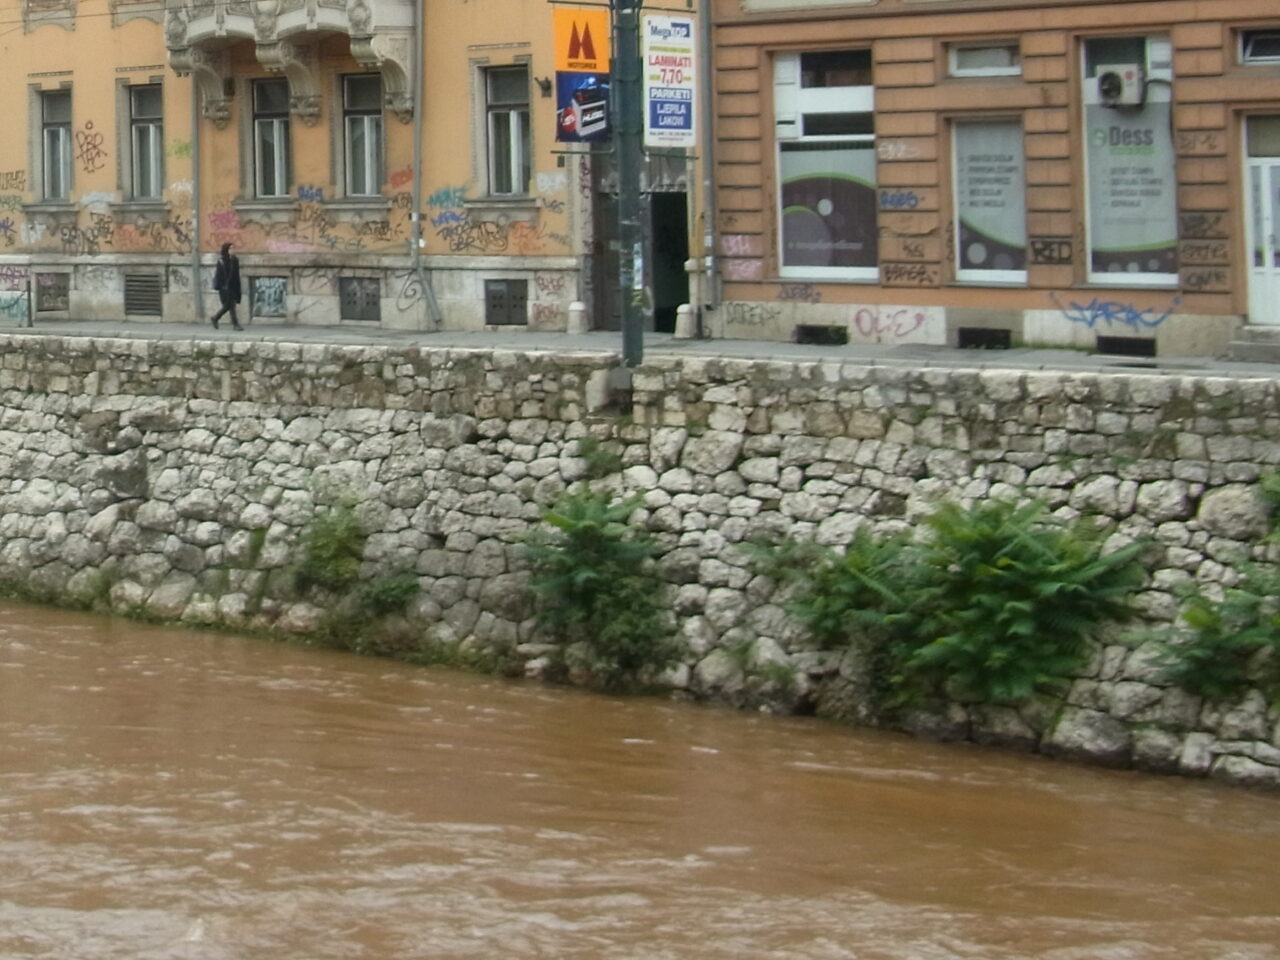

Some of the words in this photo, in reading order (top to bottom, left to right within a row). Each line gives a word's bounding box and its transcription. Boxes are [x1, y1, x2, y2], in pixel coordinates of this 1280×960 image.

[648, 54, 691, 68] LAMINATI
[660, 68, 683, 86] 7,70
[650, 88, 691, 100] PARKETI
[657, 103, 686, 115] LJEPILA
[1109, 126, 1154, 146] Dess
[1030, 240, 1072, 265] RED
